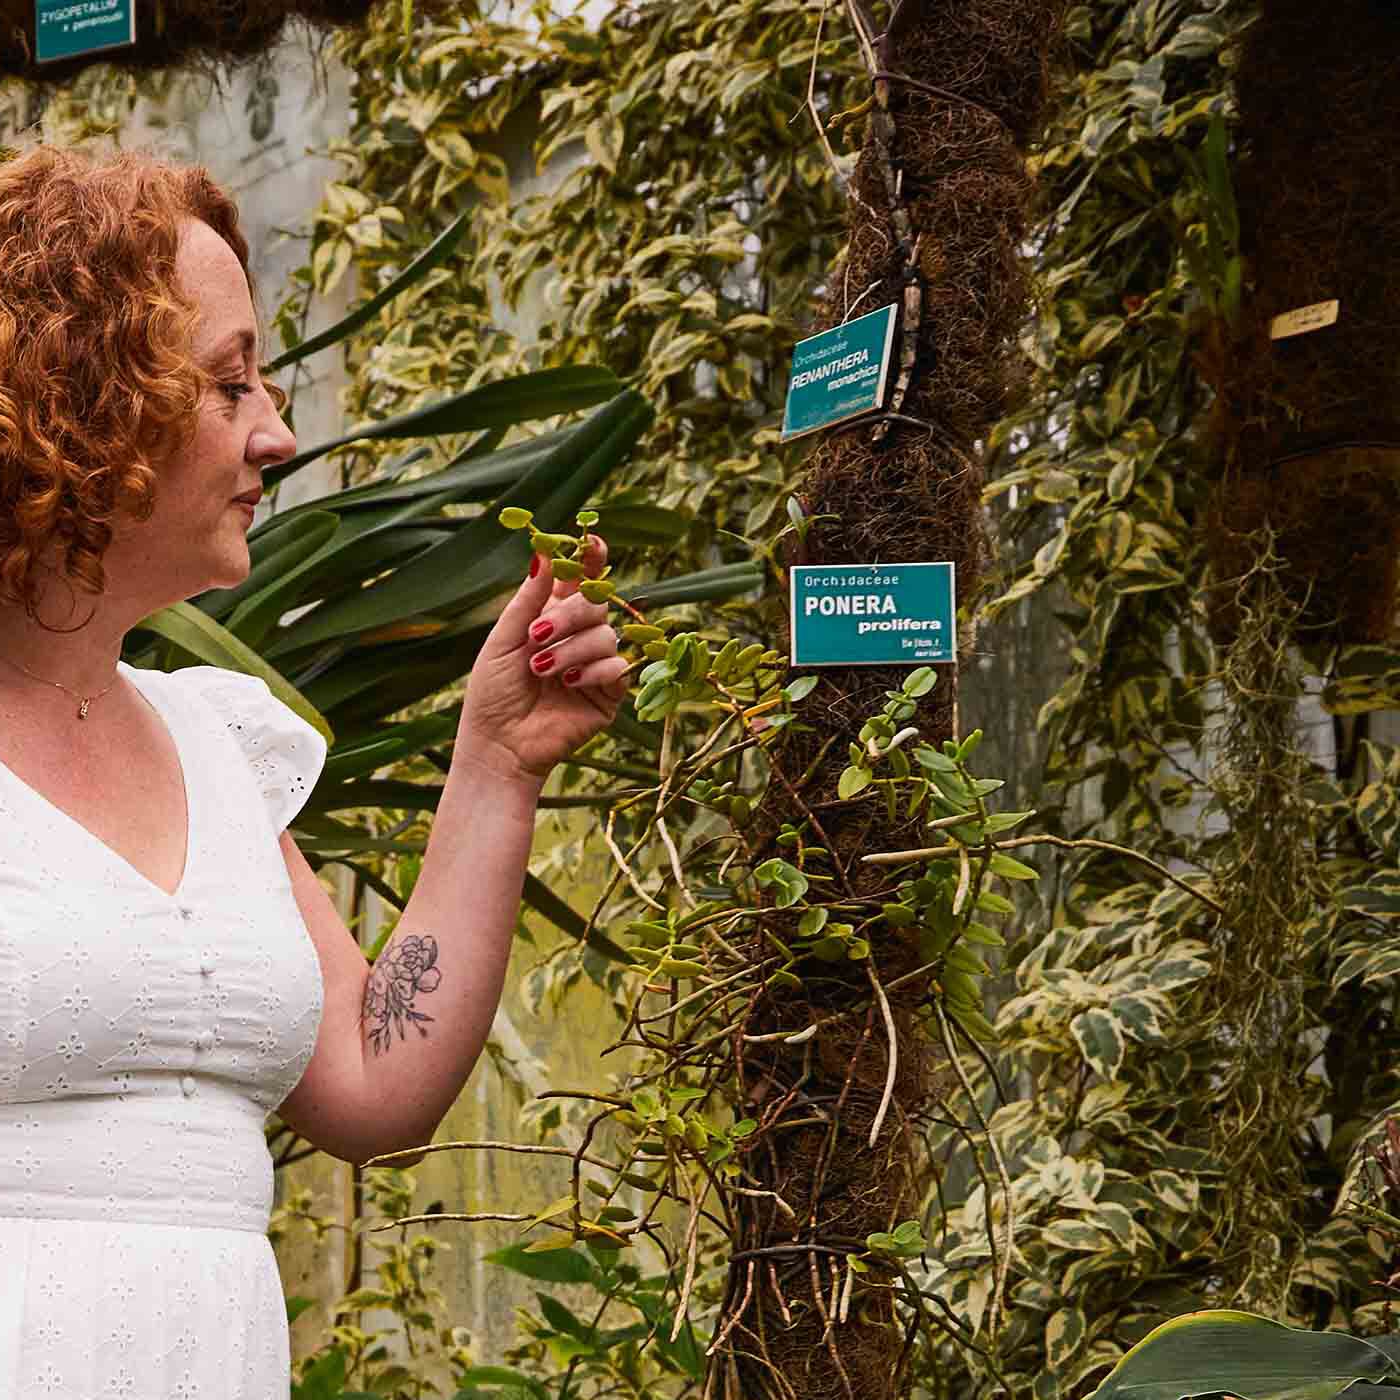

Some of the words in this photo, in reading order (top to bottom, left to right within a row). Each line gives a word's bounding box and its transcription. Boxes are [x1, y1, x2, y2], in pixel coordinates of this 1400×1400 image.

[791, 348, 869, 391] RENANTHERA
[804, 575, 900, 588] Orchidaceae
[804, 594, 897, 616] PONERA
[857, 618, 942, 635] prolifera
